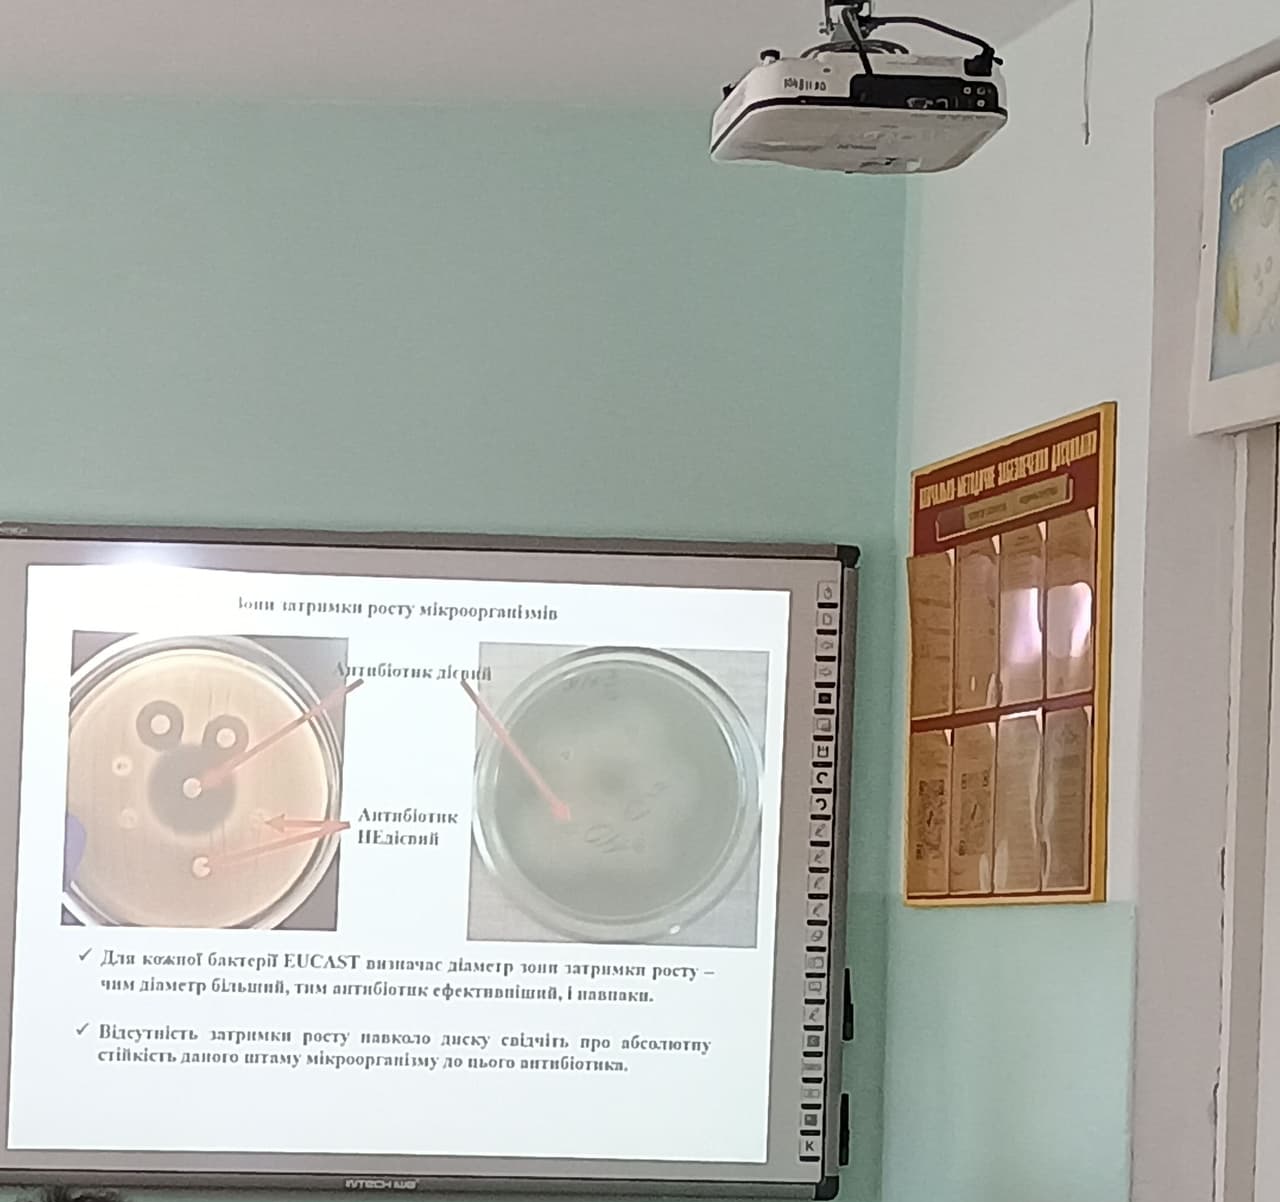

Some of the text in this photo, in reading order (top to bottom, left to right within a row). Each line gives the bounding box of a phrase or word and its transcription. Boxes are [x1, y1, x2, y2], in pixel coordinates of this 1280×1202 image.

[367, 602, 415, 619] росту
[419, 602, 558, 621] мікроорганізмів
[358, 808, 459, 824] Антибіотик
[358, 829, 439, 846] НЕдієвий
[100, 949, 135, 967] Для
[142, 952, 203, 967] кожної
[208, 952, 278, 971] бактерії
[284, 953, 360, 970] EUCAST
[366, 957, 441, 972] визначає
[447, 957, 514, 977] діаметр
[521, 962, 558, 975] зони
[564, 962, 646, 979] затримки
[652, 965, 699, 981] росту
[100, 976, 654, 1003] чим діаметр більший, тим антибіотик ефективніший, і навпаки.
[98, 1023, 199, 1043] Відсутність
[210, 1028, 291, 1045] затримки
[303, 1032, 350, 1047] росту
[360, 1032, 431, 1046] навколо
[441, 1033, 490, 1049] диску
[580, 1037, 611, 1052] про
[621, 1035, 712, 1055] абсолютну
[98, 1048, 628, 1072] стійкість даного штаму мікроорганізму до цього антибіотика.
